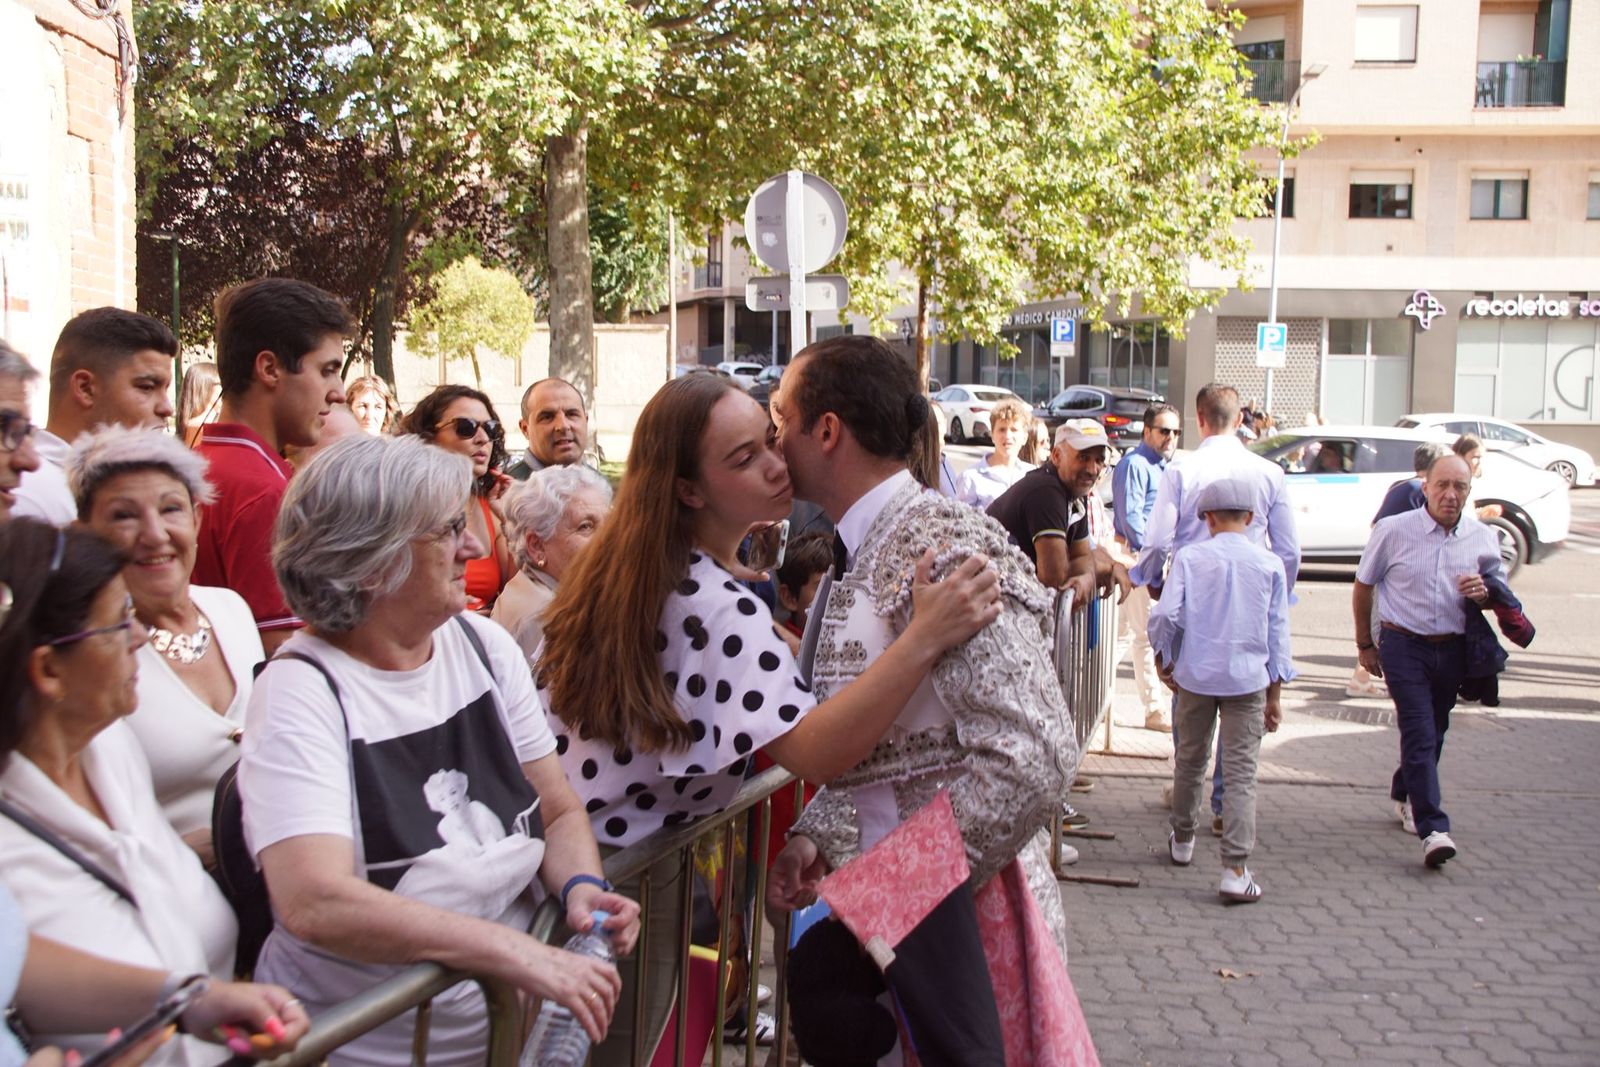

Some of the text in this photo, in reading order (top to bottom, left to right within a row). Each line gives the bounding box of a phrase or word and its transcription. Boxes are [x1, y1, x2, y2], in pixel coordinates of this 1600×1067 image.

[1466, 293, 1569, 316] recoletas
[1056, 320, 1071, 341] P
[1263, 327, 1281, 351] P
